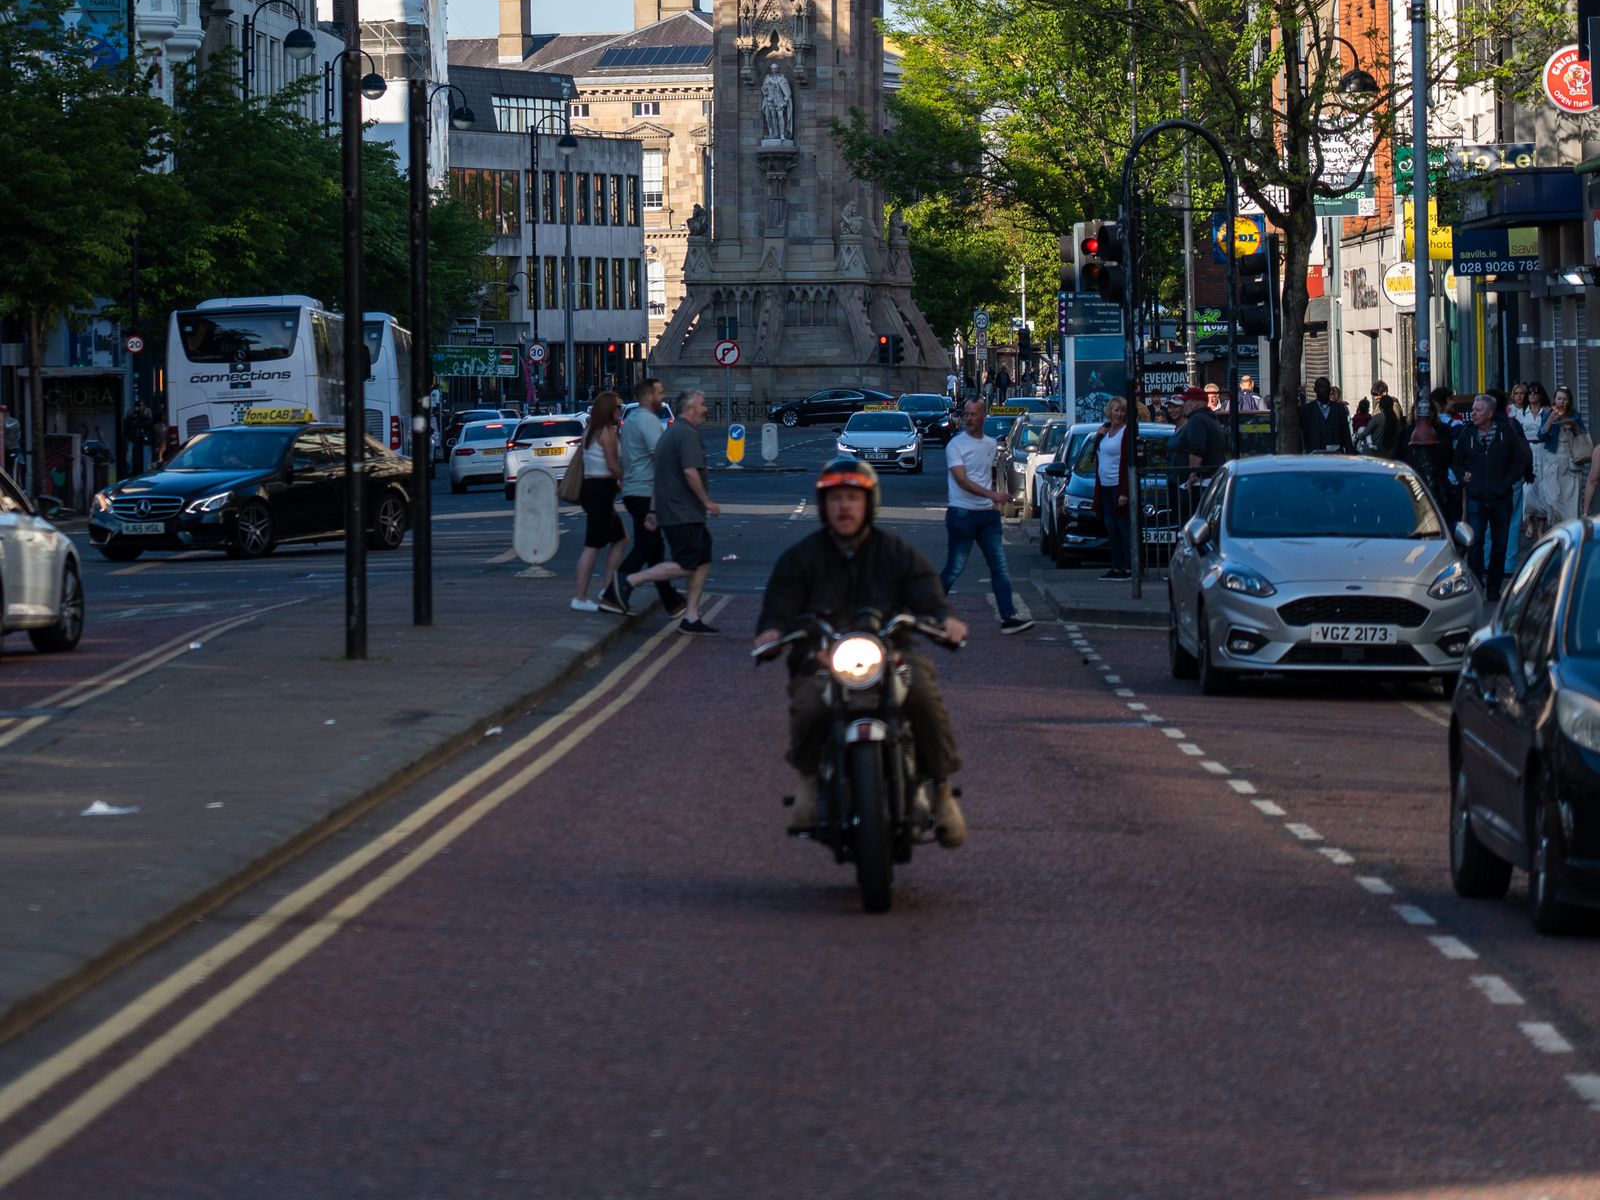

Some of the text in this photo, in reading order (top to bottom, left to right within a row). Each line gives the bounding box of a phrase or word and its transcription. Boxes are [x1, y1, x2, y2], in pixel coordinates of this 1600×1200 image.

[1551, 52, 1578, 75] Chick
[1554, 90, 1572, 106] OPEN
[1457, 151, 1491, 171] To
[1500, 149, 1537, 169] Let
[1221, 234, 1257, 242] LDL
[1429, 240, 1453, 249] hoto
[1511, 242, 1537, 255] savil
[1459, 249, 1497, 259] savills.ie
[1459, 260, 1540, 273] 028 9026 782
[129, 341, 142, 349] 20
[531, 349, 543, 357] 30
[190, 369, 292, 383] connections
[1144, 372, 1189, 383] EVERYDAY
[1144, 384, 1161, 393] LOW
[1321, 626, 1388, 641] VGZ 2173
